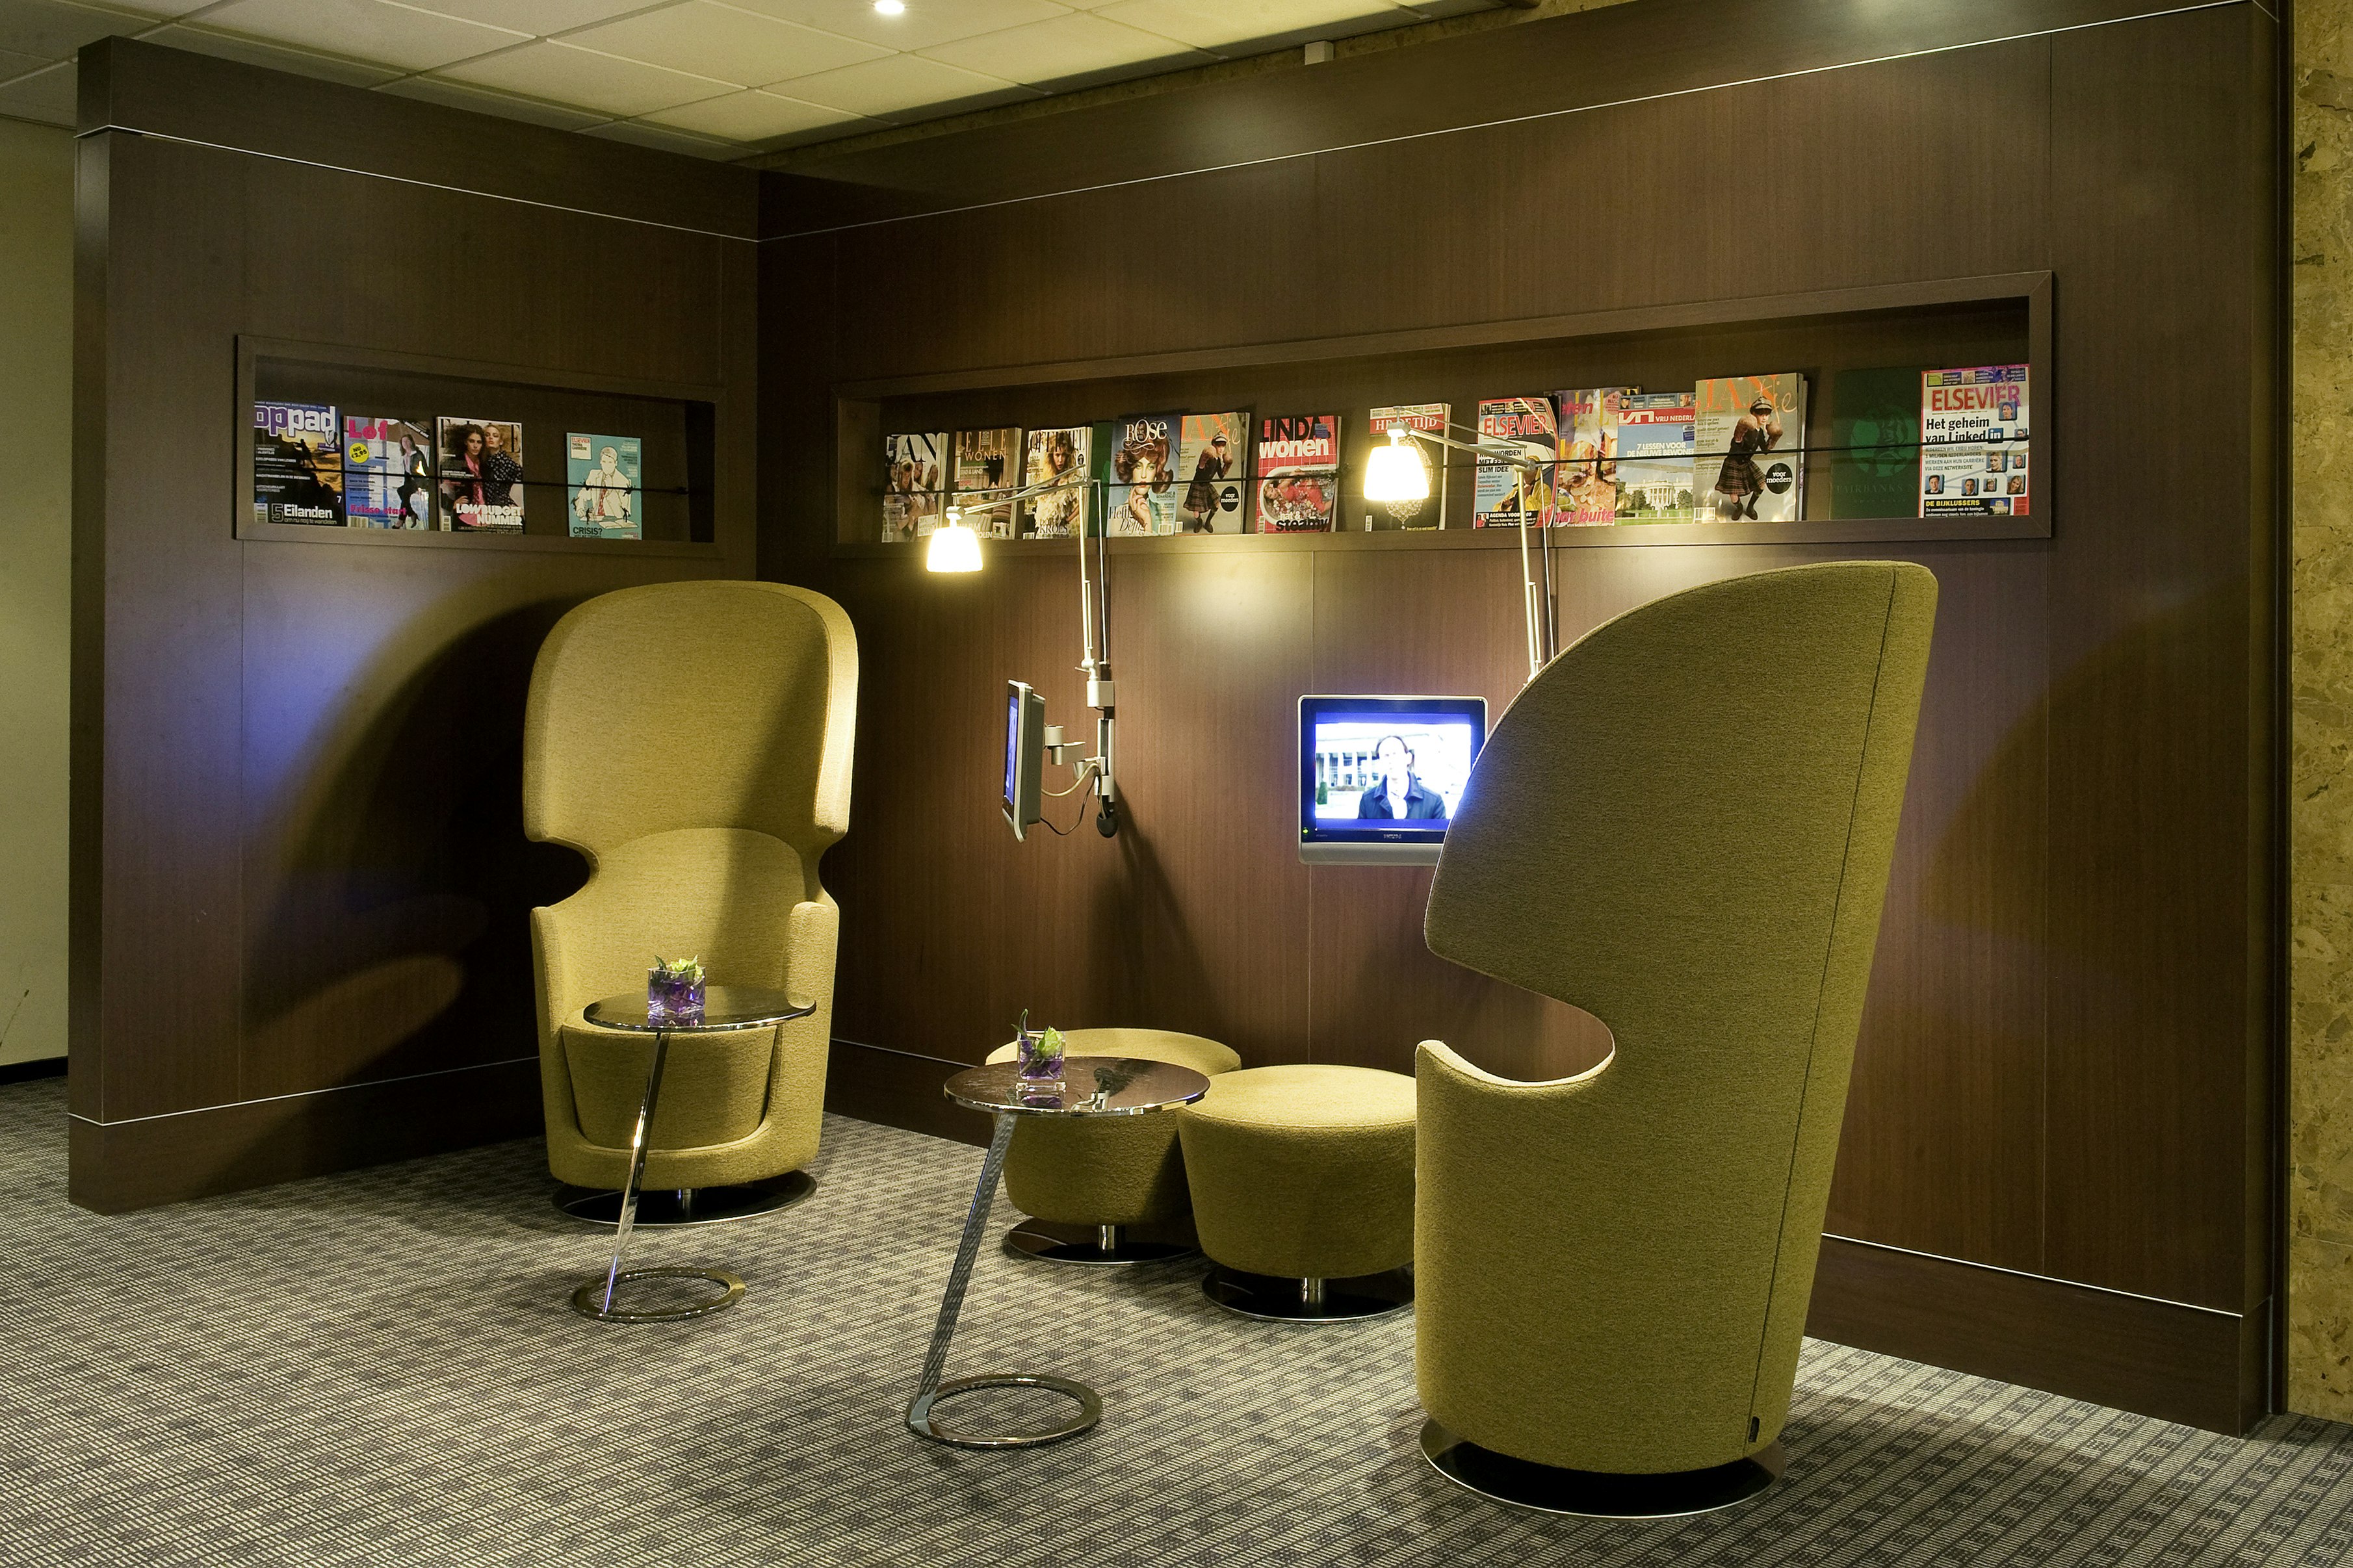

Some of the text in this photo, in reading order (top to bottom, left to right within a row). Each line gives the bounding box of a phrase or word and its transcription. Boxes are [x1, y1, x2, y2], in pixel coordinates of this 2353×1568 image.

[1932, 385, 2022, 411] ELSEVIER
[348, 419, 388, 441] Lof
[1412, 417, 1437, 430] TIJD
[1484, 415, 1550, 436] ELSEVIER
[1926, 416, 1990, 431] Het geheim
[965, 429, 1008, 452] ELLE
[1259, 439, 1329, 459] wonen
[965, 450, 1006, 461] WONEN
[337, 495, 342, 504] 7
[271, 503, 333, 522] 5 Eilanden
[476, 513, 523, 526] NUMMER
[573, 526, 603, 535] CRISIS?
